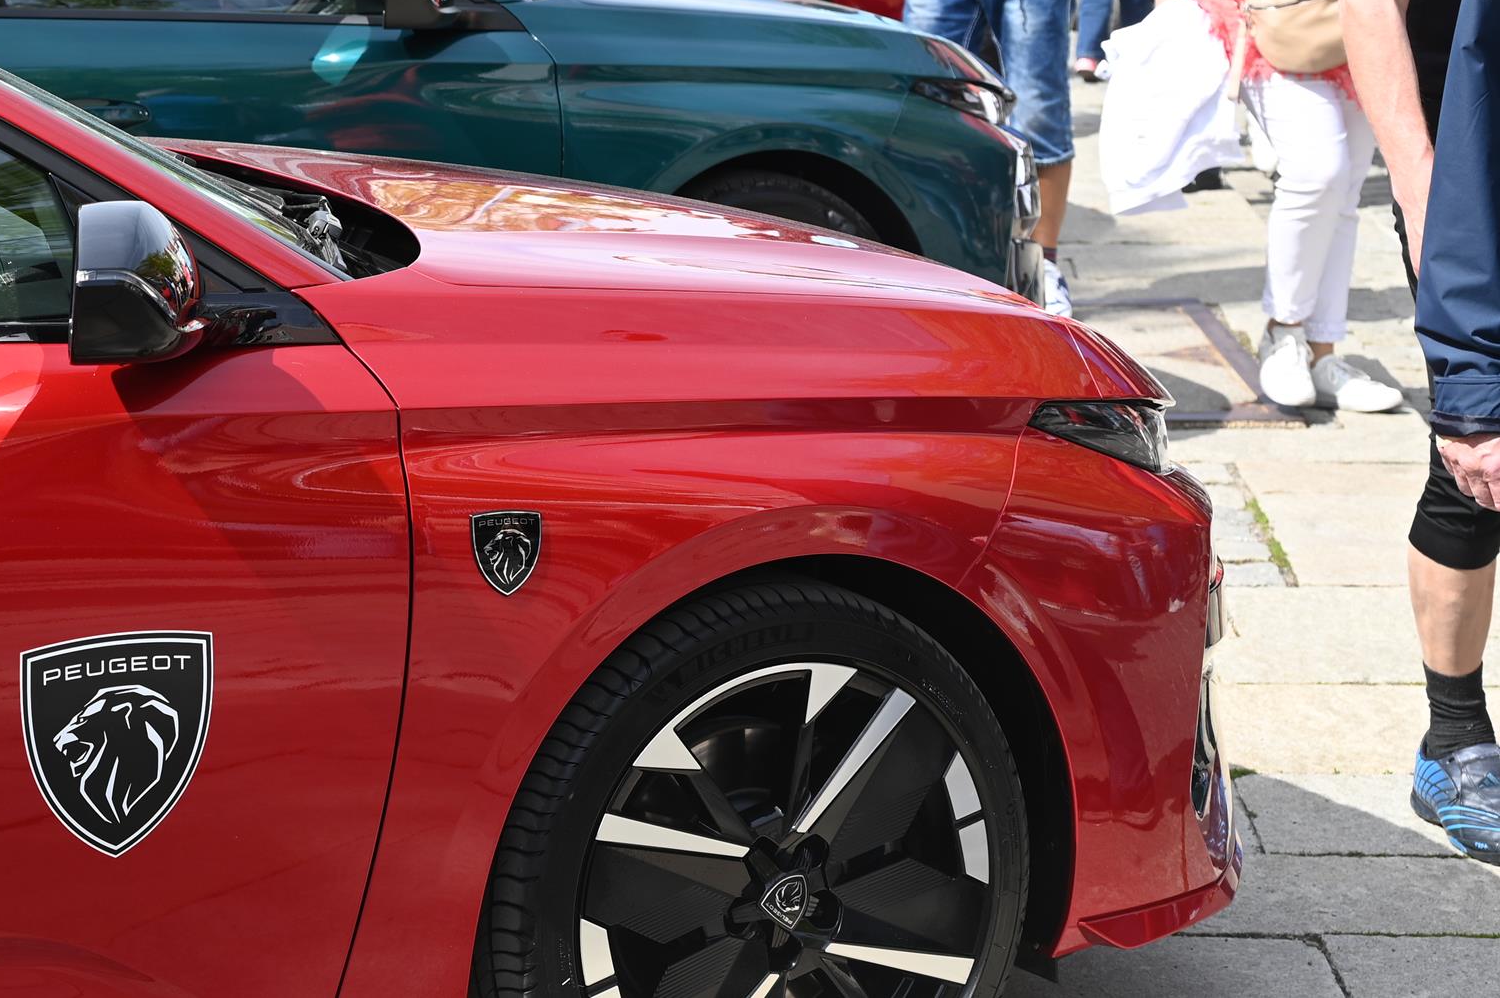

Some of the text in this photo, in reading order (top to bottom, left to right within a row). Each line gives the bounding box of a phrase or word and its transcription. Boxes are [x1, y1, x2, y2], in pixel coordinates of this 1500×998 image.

[479, 517, 536, 528] PEUGEOT
[43, 654, 192, 686] PEUGEOT
[765, 902, 794, 925] PEUGEOT
